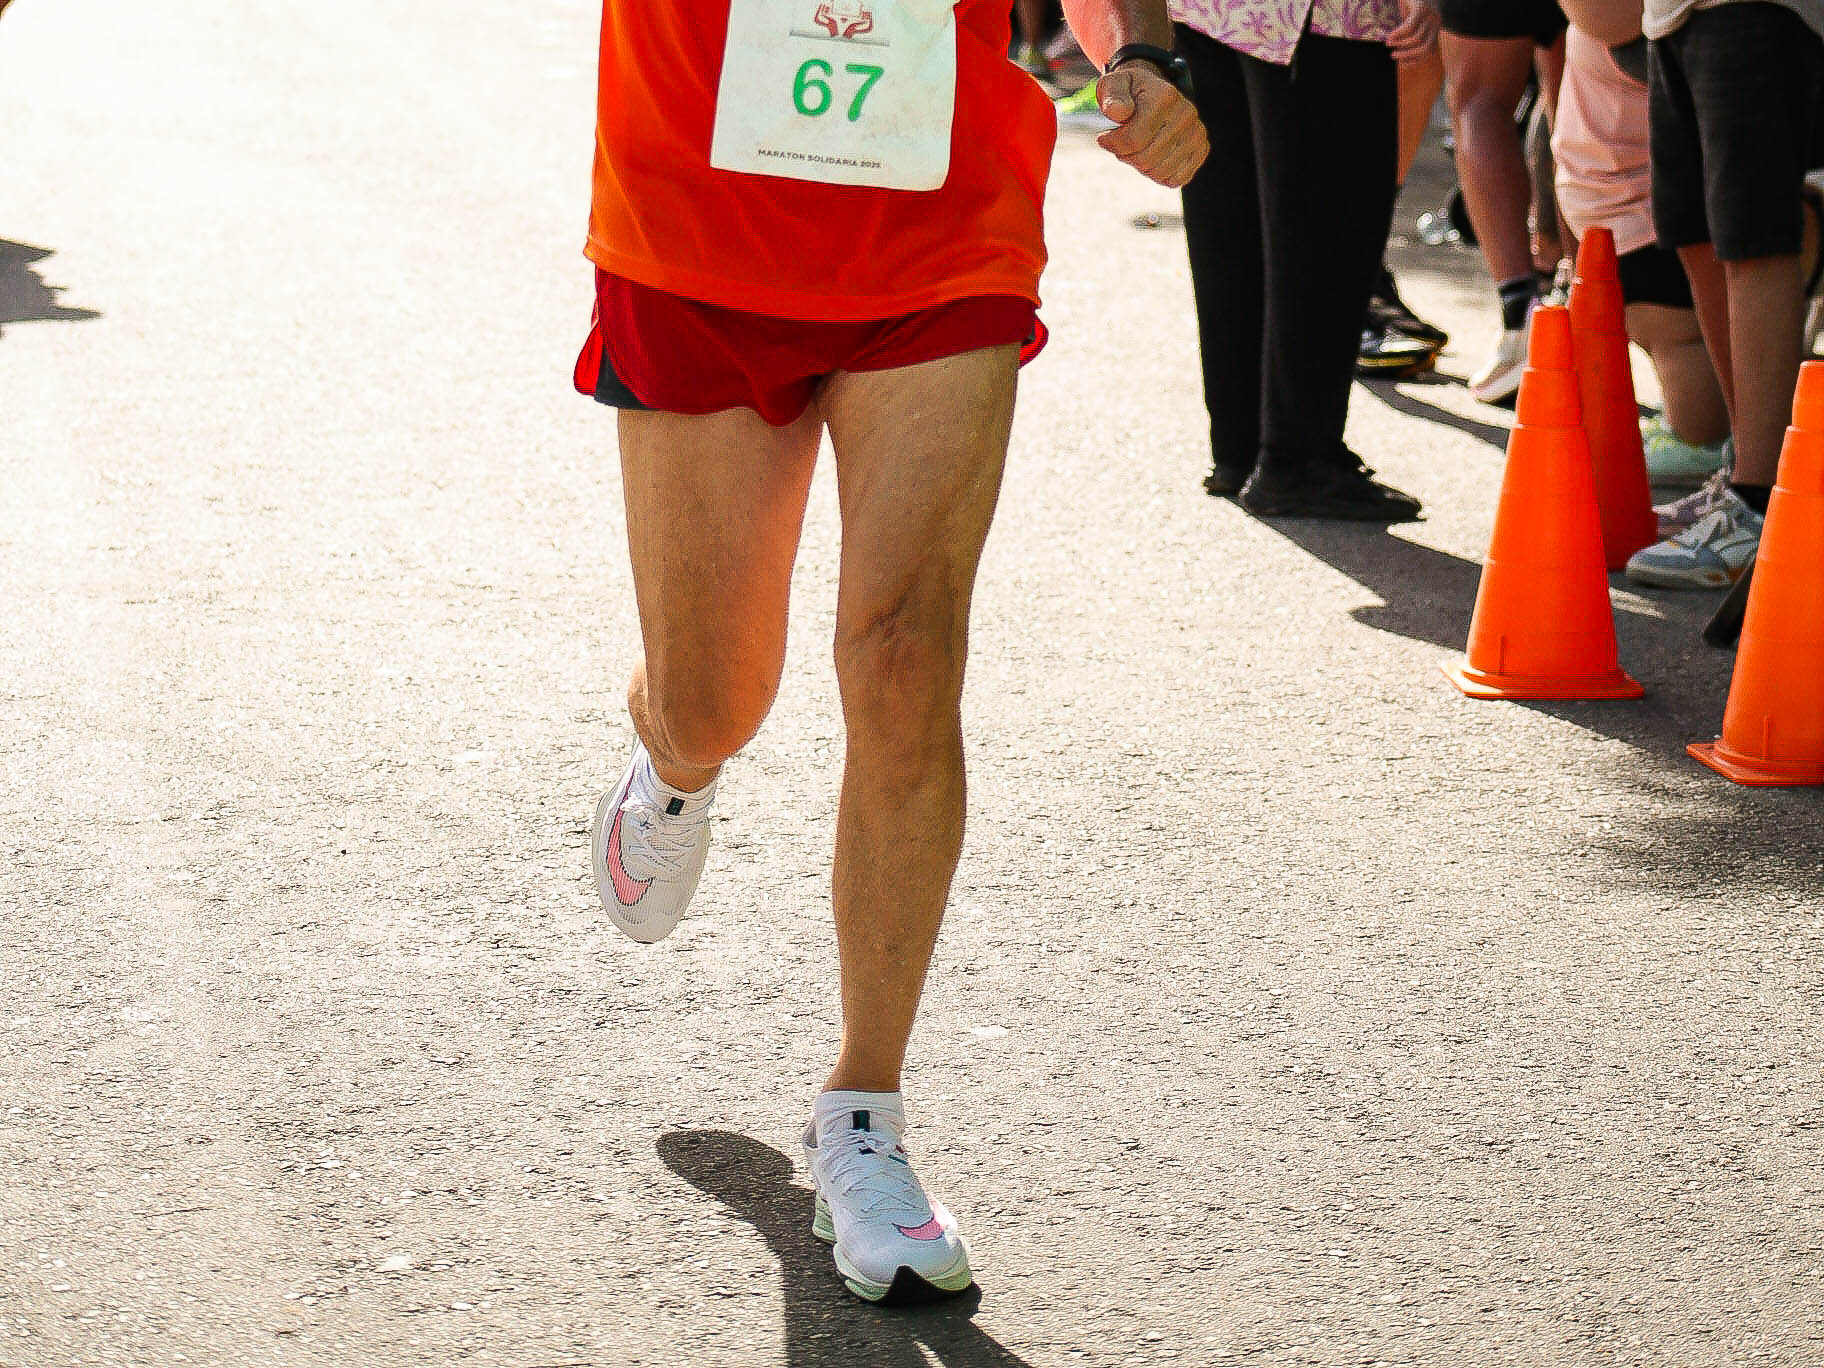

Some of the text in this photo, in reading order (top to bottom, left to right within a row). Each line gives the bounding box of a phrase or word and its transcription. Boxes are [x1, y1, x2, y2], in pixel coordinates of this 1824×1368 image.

[792, 58, 885, 123] 67
[757, 149, 806, 161] MARATON
[807, 154, 858, 167] SOLIDARIA
